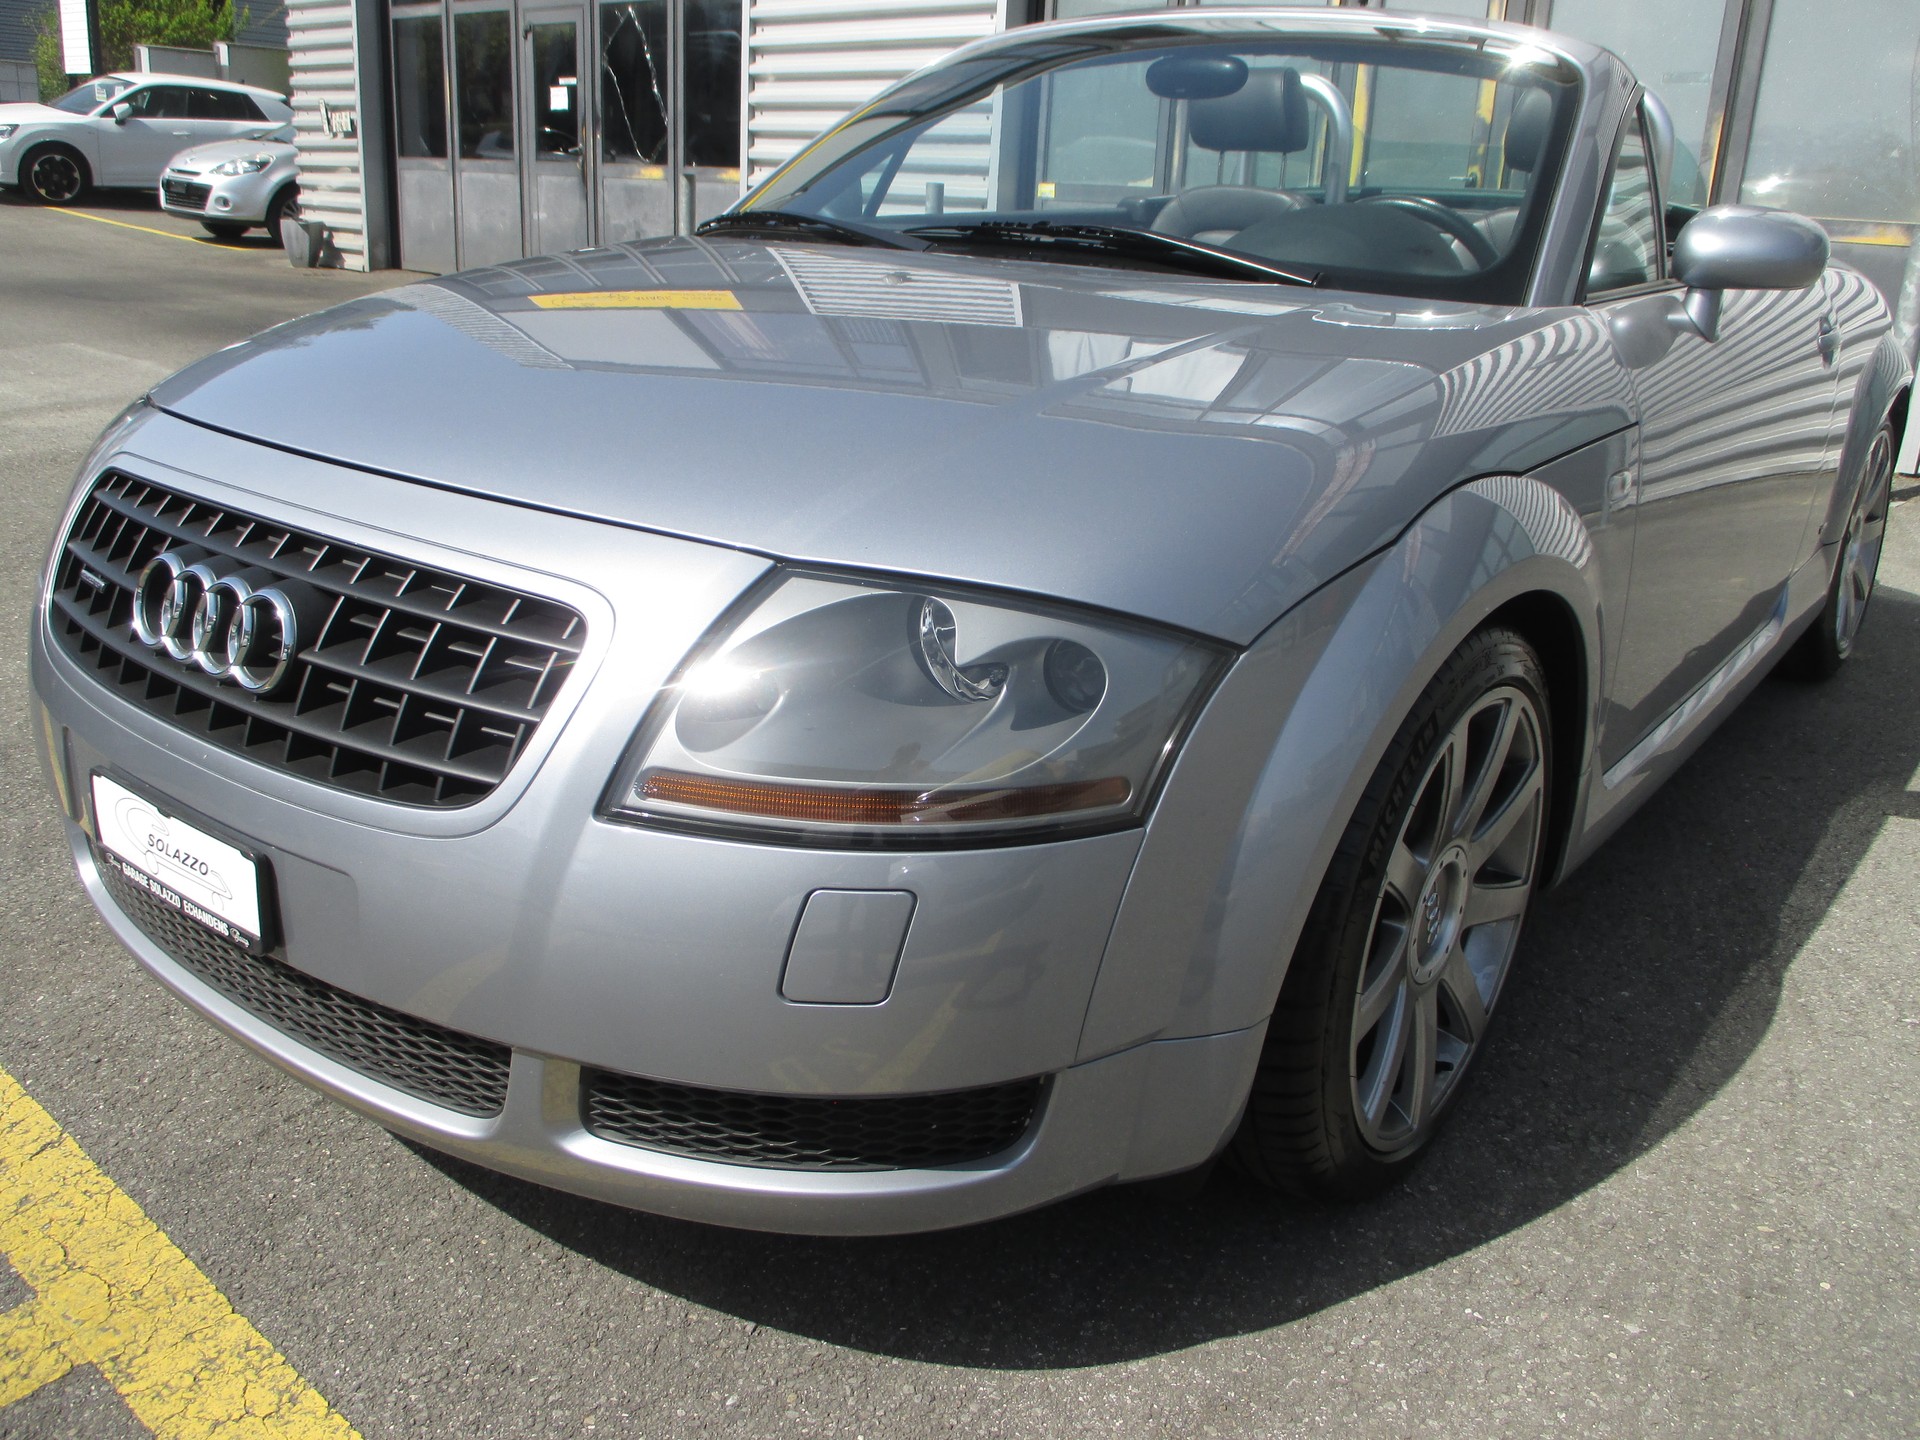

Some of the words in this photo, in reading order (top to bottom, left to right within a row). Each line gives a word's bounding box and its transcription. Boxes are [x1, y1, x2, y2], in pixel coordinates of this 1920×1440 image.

[1368, 722, 1435, 867] MICHELIN
[148, 833, 209, 876] SOLAZZO
[122, 862, 150, 889] GARAGE
[150, 879, 181, 909] SOLAZZO
[183, 899, 229, 937] ECHANDENS
